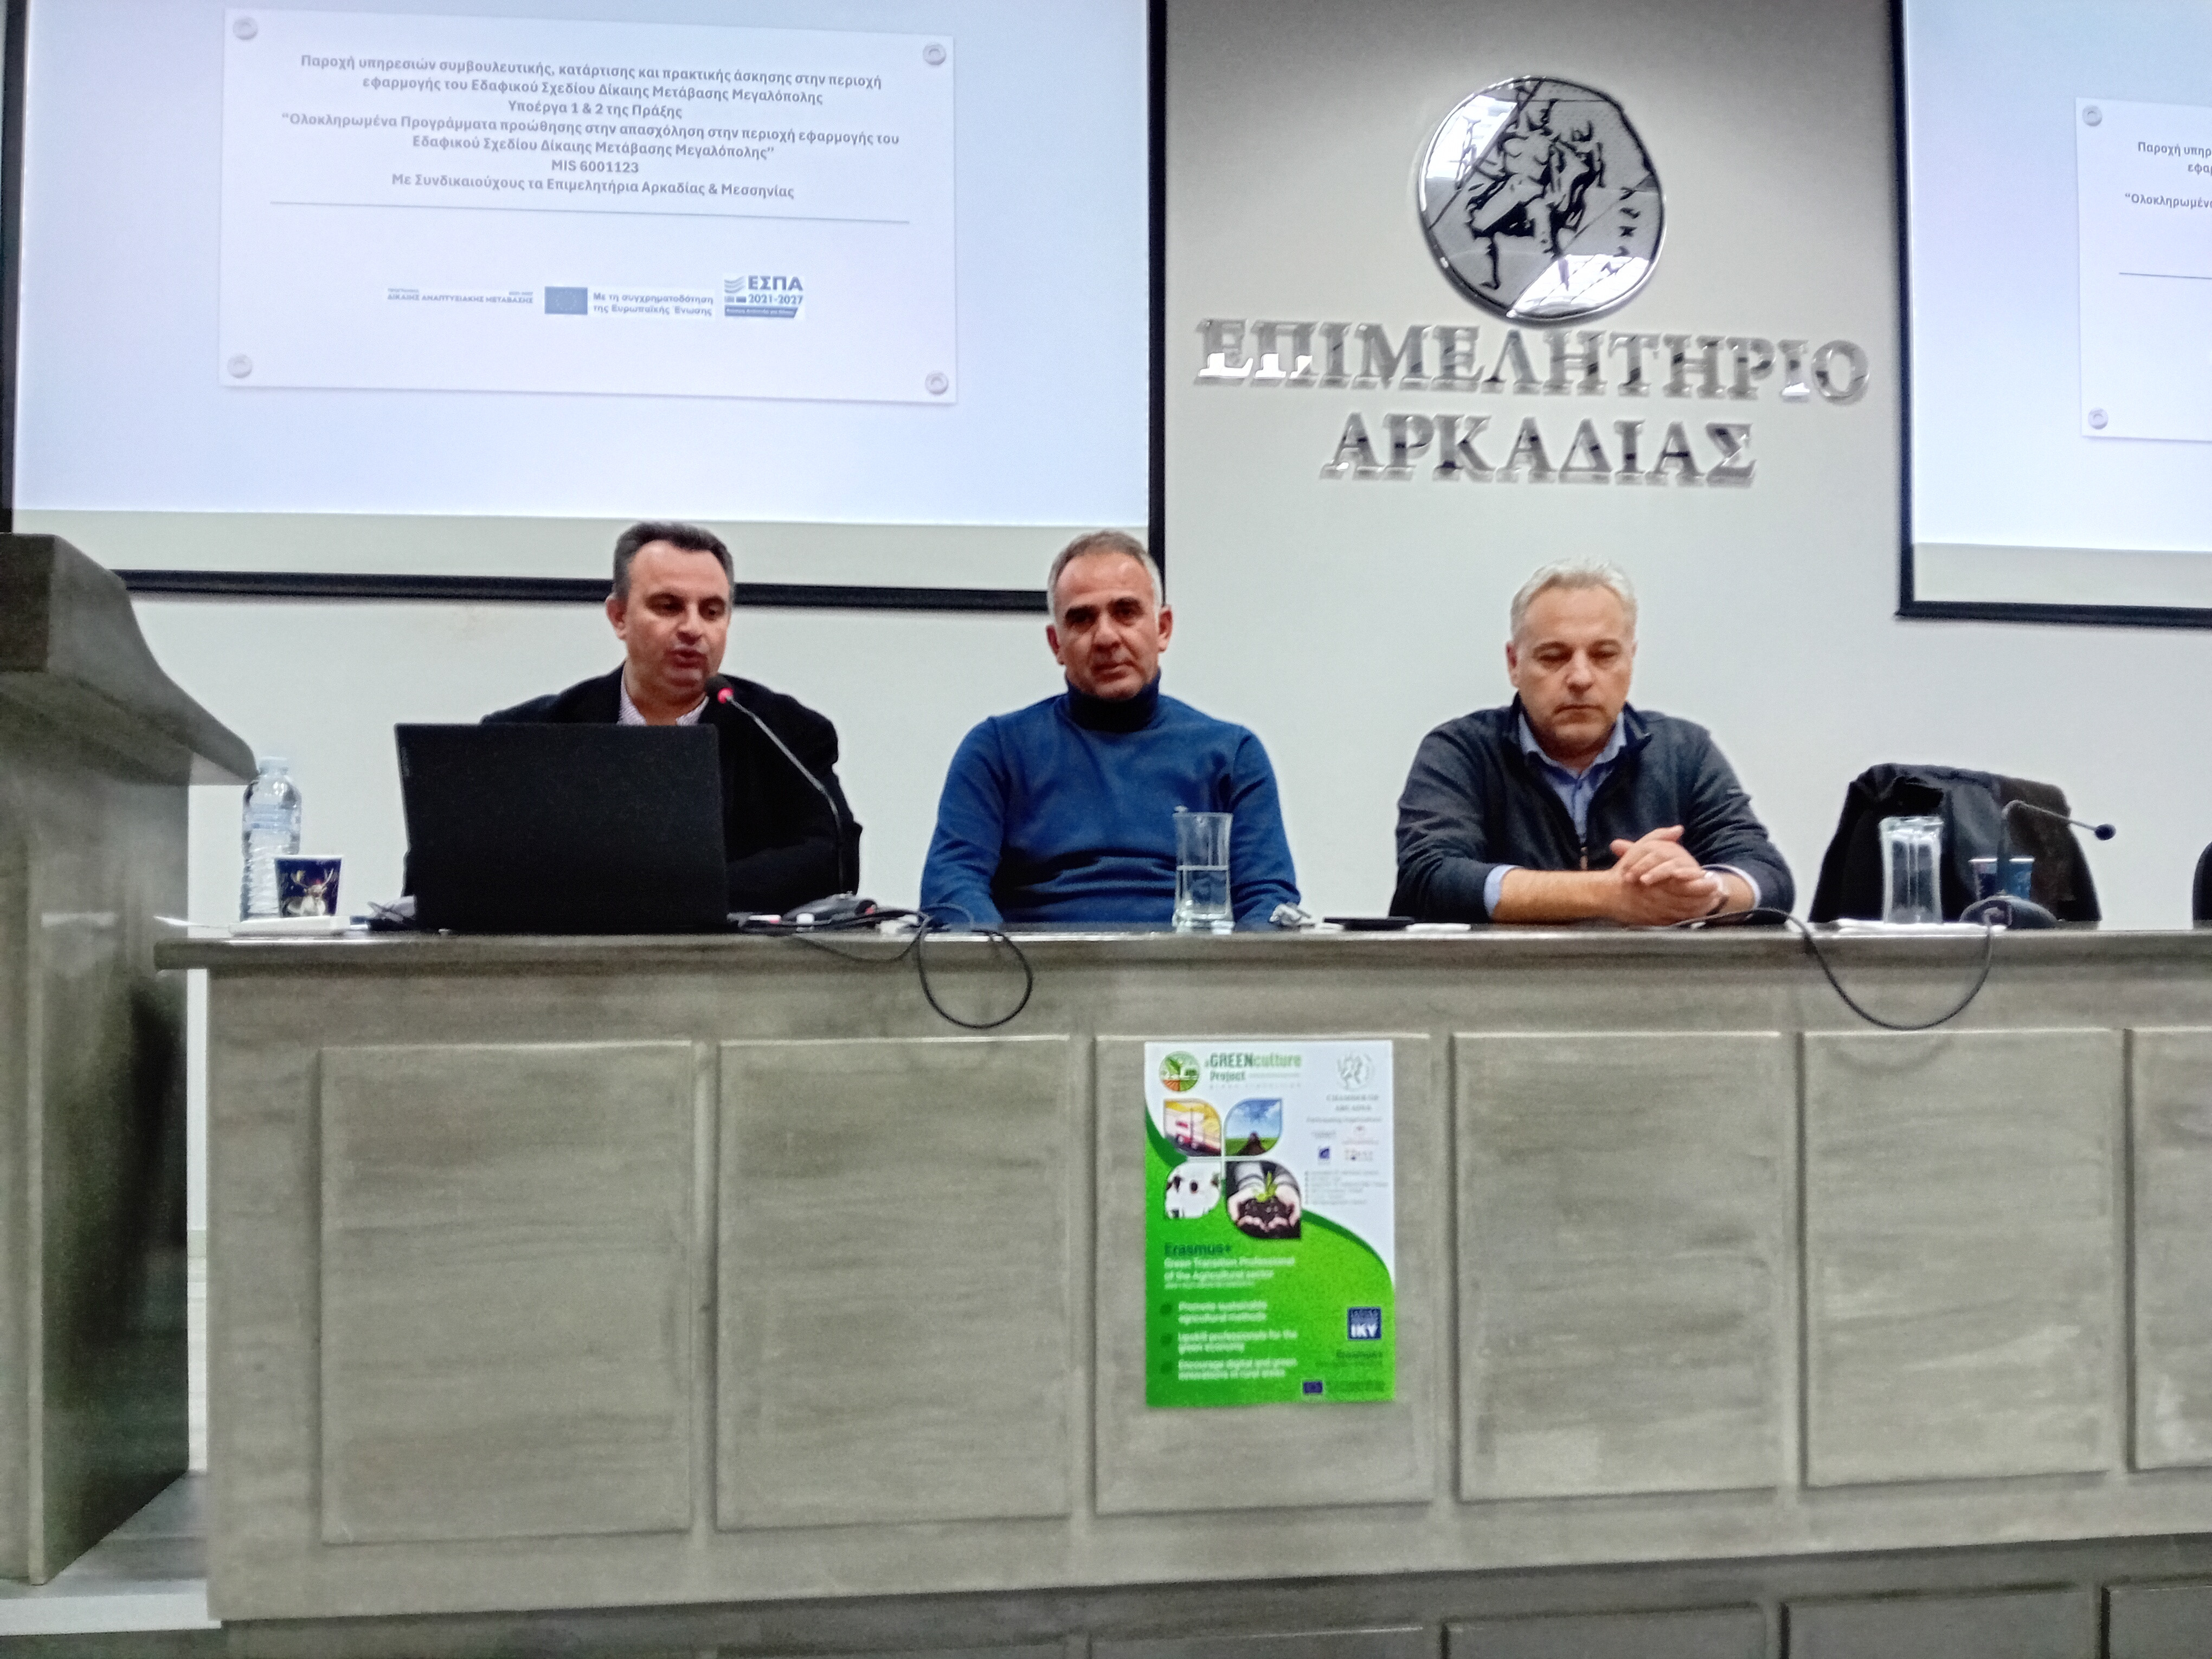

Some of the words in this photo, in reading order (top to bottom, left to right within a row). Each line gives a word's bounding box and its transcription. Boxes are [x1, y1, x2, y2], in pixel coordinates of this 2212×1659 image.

[301, 55, 355, 70] Παροχή
[359, 58, 436, 72] υπηρεσιών
[439, 60, 555, 76] συμβουλευτικής,
[559, 64, 635, 80] κατάρτισης
[639, 69, 659, 78] και
[663, 69, 731, 83] πρακτικής
[734, 69, 792, 86] άσκησης
[795, 75, 826, 87] στην
[828, 75, 882, 90] περιοχή
[363, 76, 441, 92] εφαρμογής
[445, 81, 468, 91] του
[472, 79, 538, 94] Εδαφικού
[542, 82, 595, 96] Σχεδίου
[599, 83, 649, 99] Δίκαιης
[652, 86, 729, 102] Μετάβασης
[732, 87, 822, 105] Μεγαλόπολης
[509, 100, 567, 115] Υποέργα
[571, 102, 578, 114] 1
[582, 103, 591, 114] &
[595, 103, 603, 114] 2
[607, 106, 628, 118] της
[632, 104, 682, 119] Πράξης
[401, 116, 497, 132] Προγράμματα
[500, 120, 582, 136] προώθησης
[585, 125, 616, 137] στην
[620, 125, 704, 140] απασχόληση
[708, 128, 738, 140] στην
[742, 128, 795, 143] περιοχή
[799, 131, 873, 146] εφαρμογής
[877, 135, 899, 144] του
[413, 135, 480, 150] Εδαφικού
[484, 138, 537, 152] Σχεδίου
[541, 139, 591, 155] Δίκαιης
[595, 142, 672, 157] Μετάβασης
[2138, 142, 2181, 157] Παροχή
[2184, 146, 2212, 159] υπηρ
[552, 159, 577, 171] MIS
[580, 160, 639, 173] 6001123
[392, 173, 411, 185] Με
[415, 174, 525, 191] Συνδικαιούχους
[529, 180, 543, 189] τα
[547, 178, 639, 194] Επιμελητήρια
[641, 181, 705, 196] Αρκαδίας
[708, 183, 717, 195] &
[722, 184, 794, 200] Μεσσηνίας
[748, 275, 803, 291] ΕΣΠΑ
[593, 292, 606, 300] Με
[608, 293, 619, 302] τη
[621, 293, 714, 305] συγχρηματοδότηση
[749, 294, 802, 304] 2021-2027
[593, 305, 608, 313] της
[611, 305, 670, 315] Ευρωπαϊκής
[1194, 319, 1870, 404] ΕΠΙΜΕΛΗΤΗΡΙΟ
[1321, 412, 1757, 487] ΑΡΚΑΔΙΑΣ
